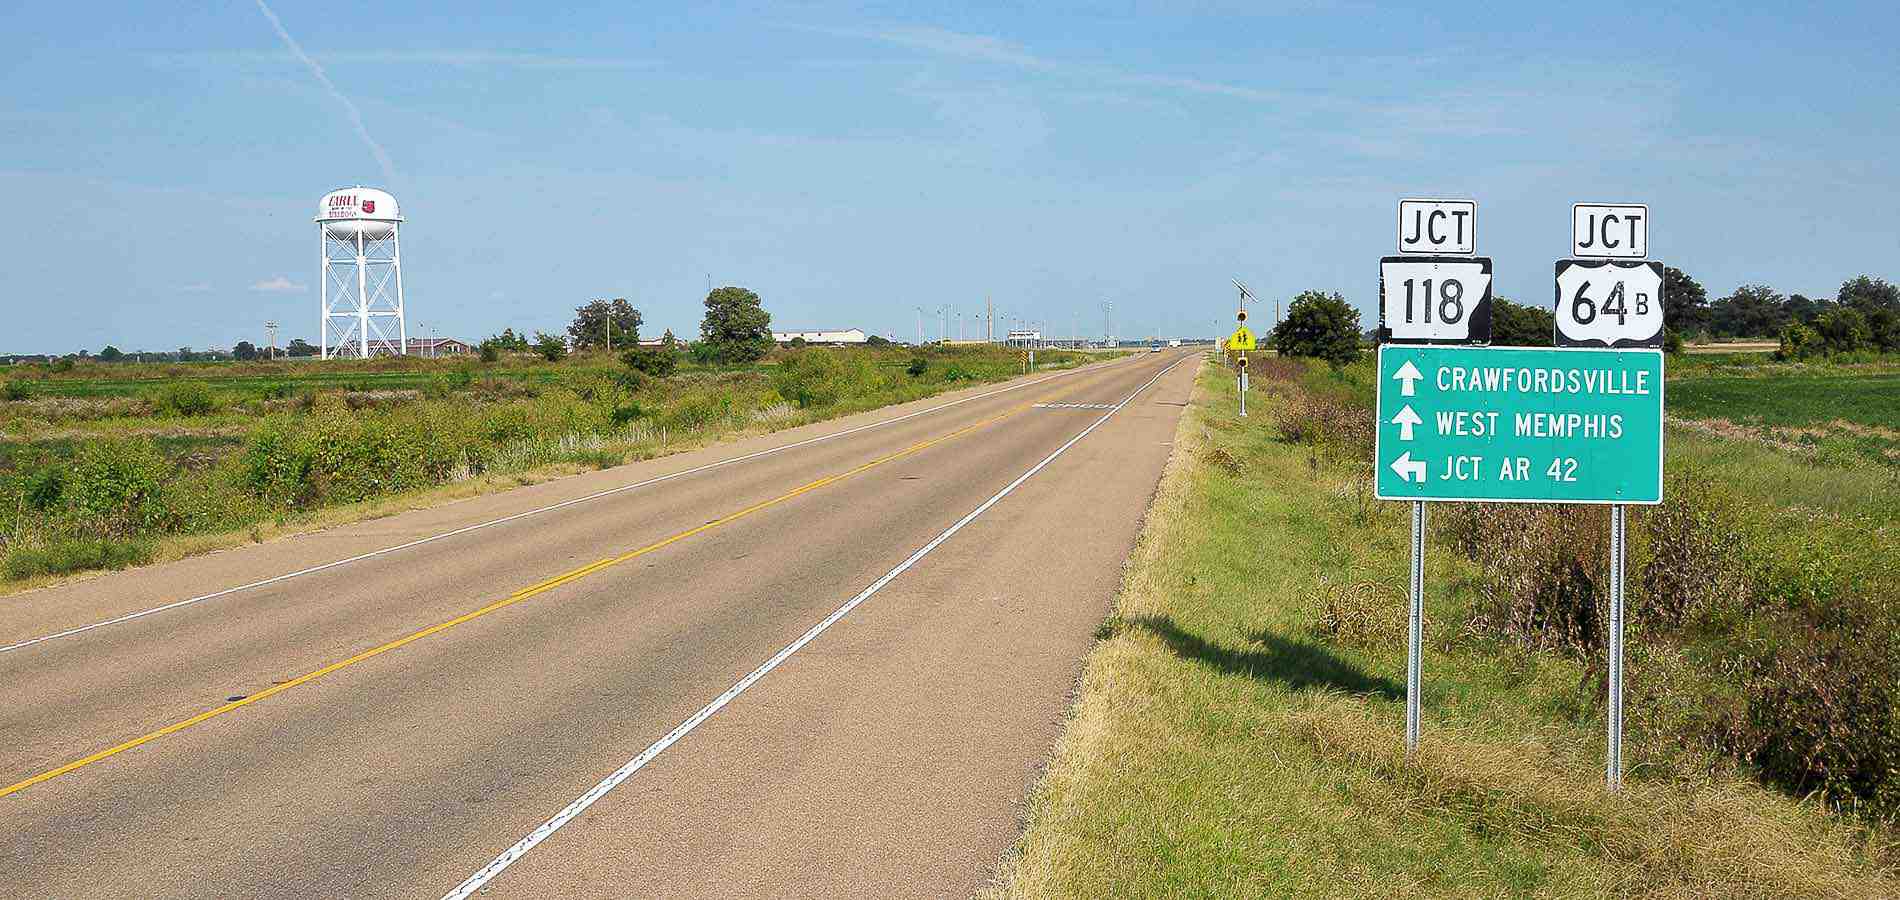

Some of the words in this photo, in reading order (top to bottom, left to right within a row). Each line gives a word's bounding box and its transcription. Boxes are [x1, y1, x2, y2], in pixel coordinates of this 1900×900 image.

[1404, 209, 1469, 245] JCT
[1577, 214, 1642, 249] JCT
[1403, 278, 1464, 325] 118
[1436, 366, 1650, 395] CRAWFORDSVILLE
[1436, 411, 1499, 437] WEST
[1515, 413, 1623, 439] MEMPHIS
[1440, 455, 1483, 481] JCT
[1499, 457, 1531, 481] AR
[1546, 457, 1579, 482] 42
